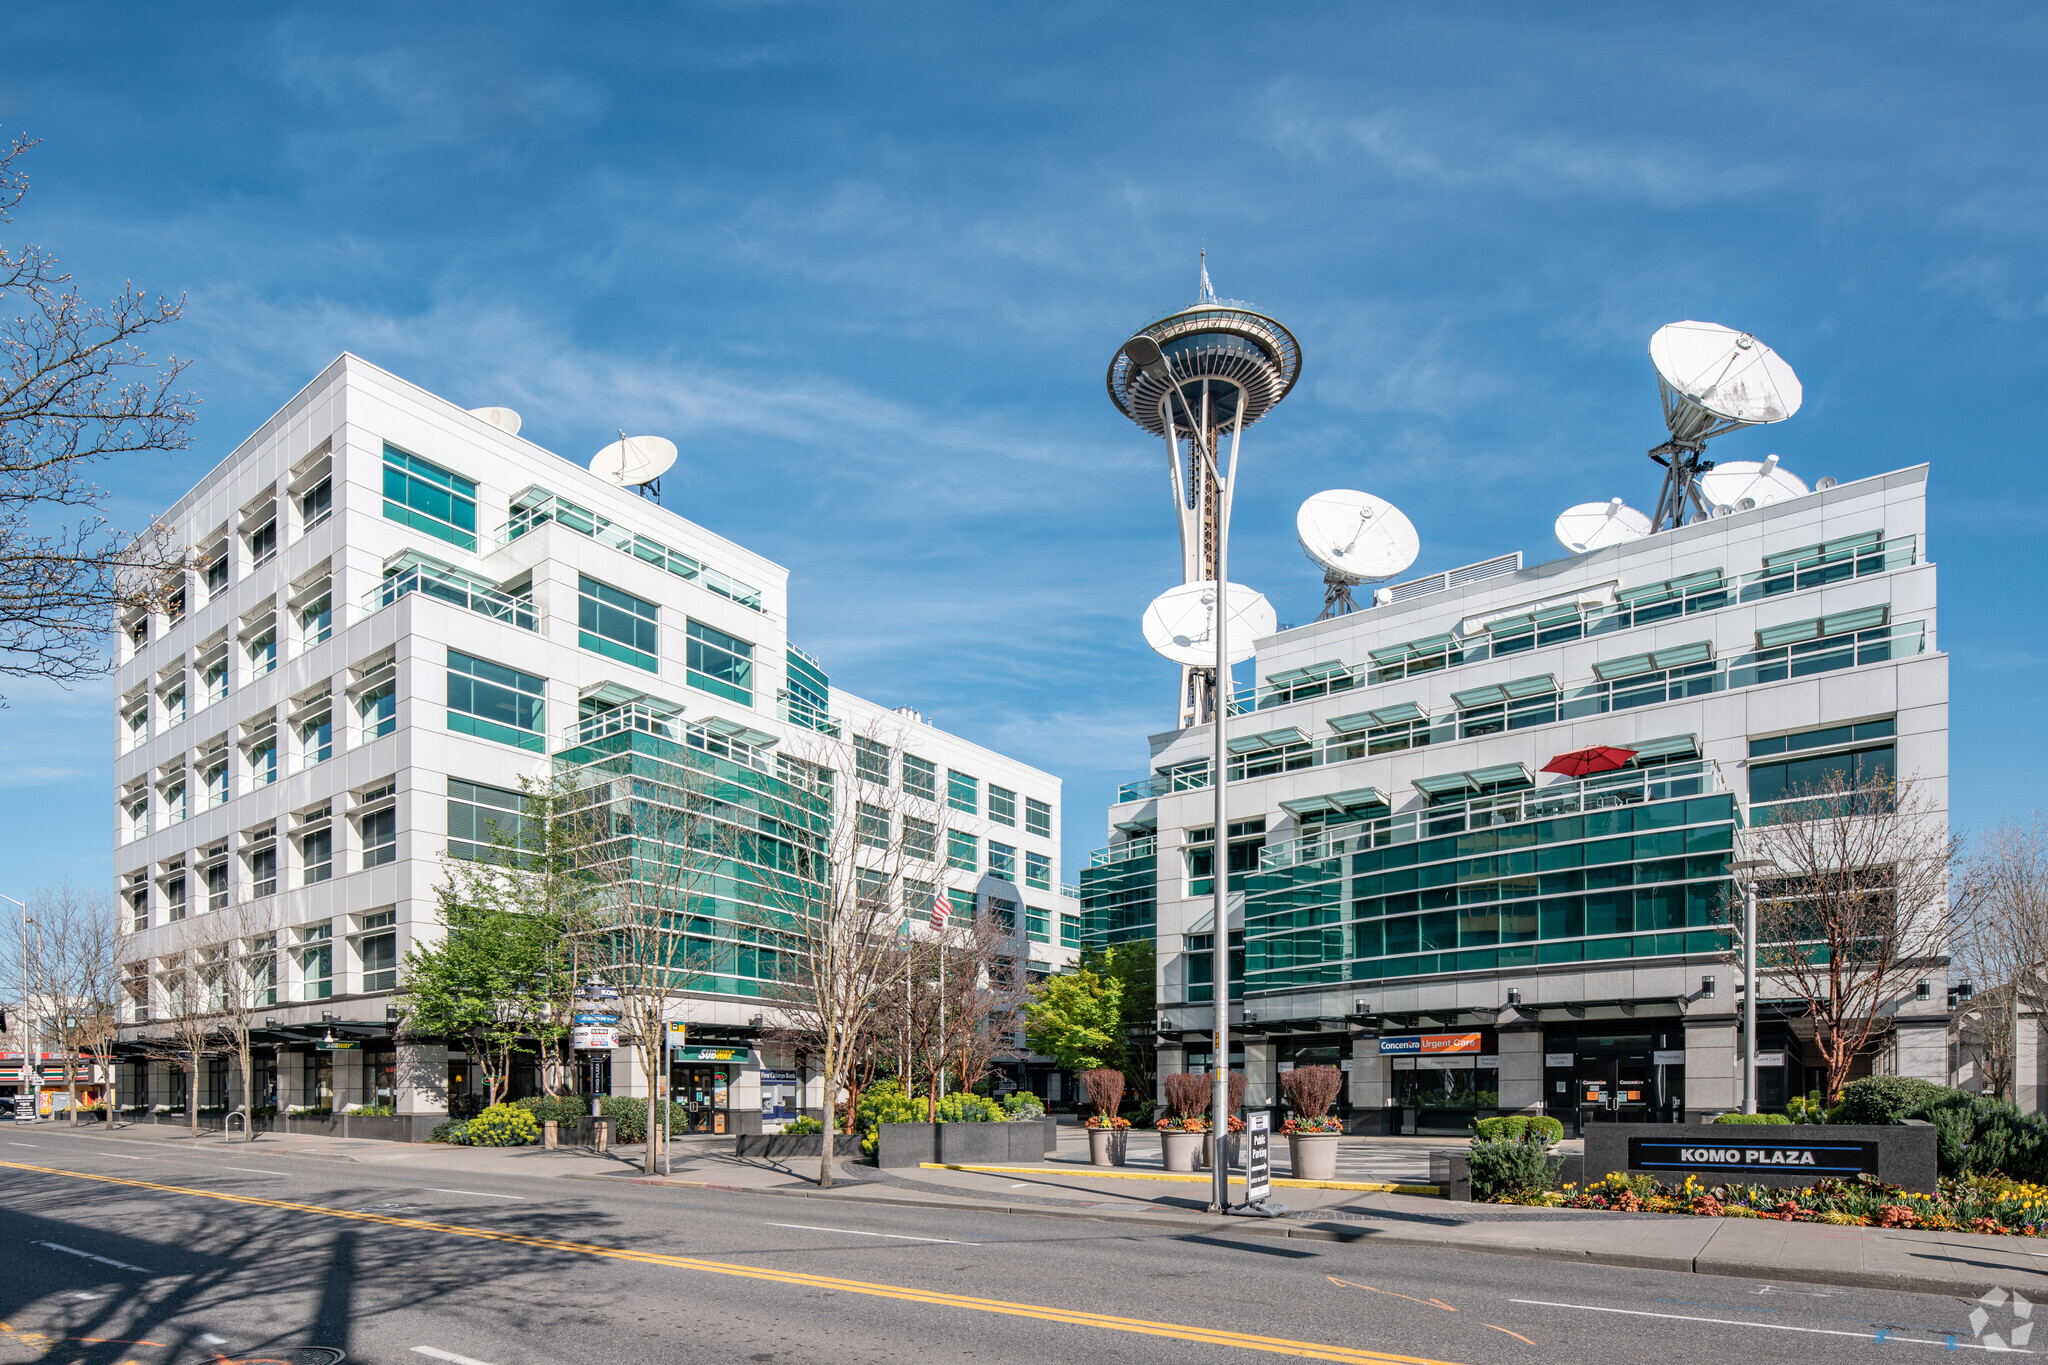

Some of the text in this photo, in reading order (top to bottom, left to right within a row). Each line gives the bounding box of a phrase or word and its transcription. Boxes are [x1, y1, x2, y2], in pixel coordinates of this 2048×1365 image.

[1381, 1038, 1475, 1050] Concentra Urgent Care
[698, 1049, 735, 1060] SUBWAY
[1254, 1135, 1266, 1146] Public
[1252, 1147, 1267, 1159] Parking
[1681, 1148, 1816, 1165] KOMO PLAZA
